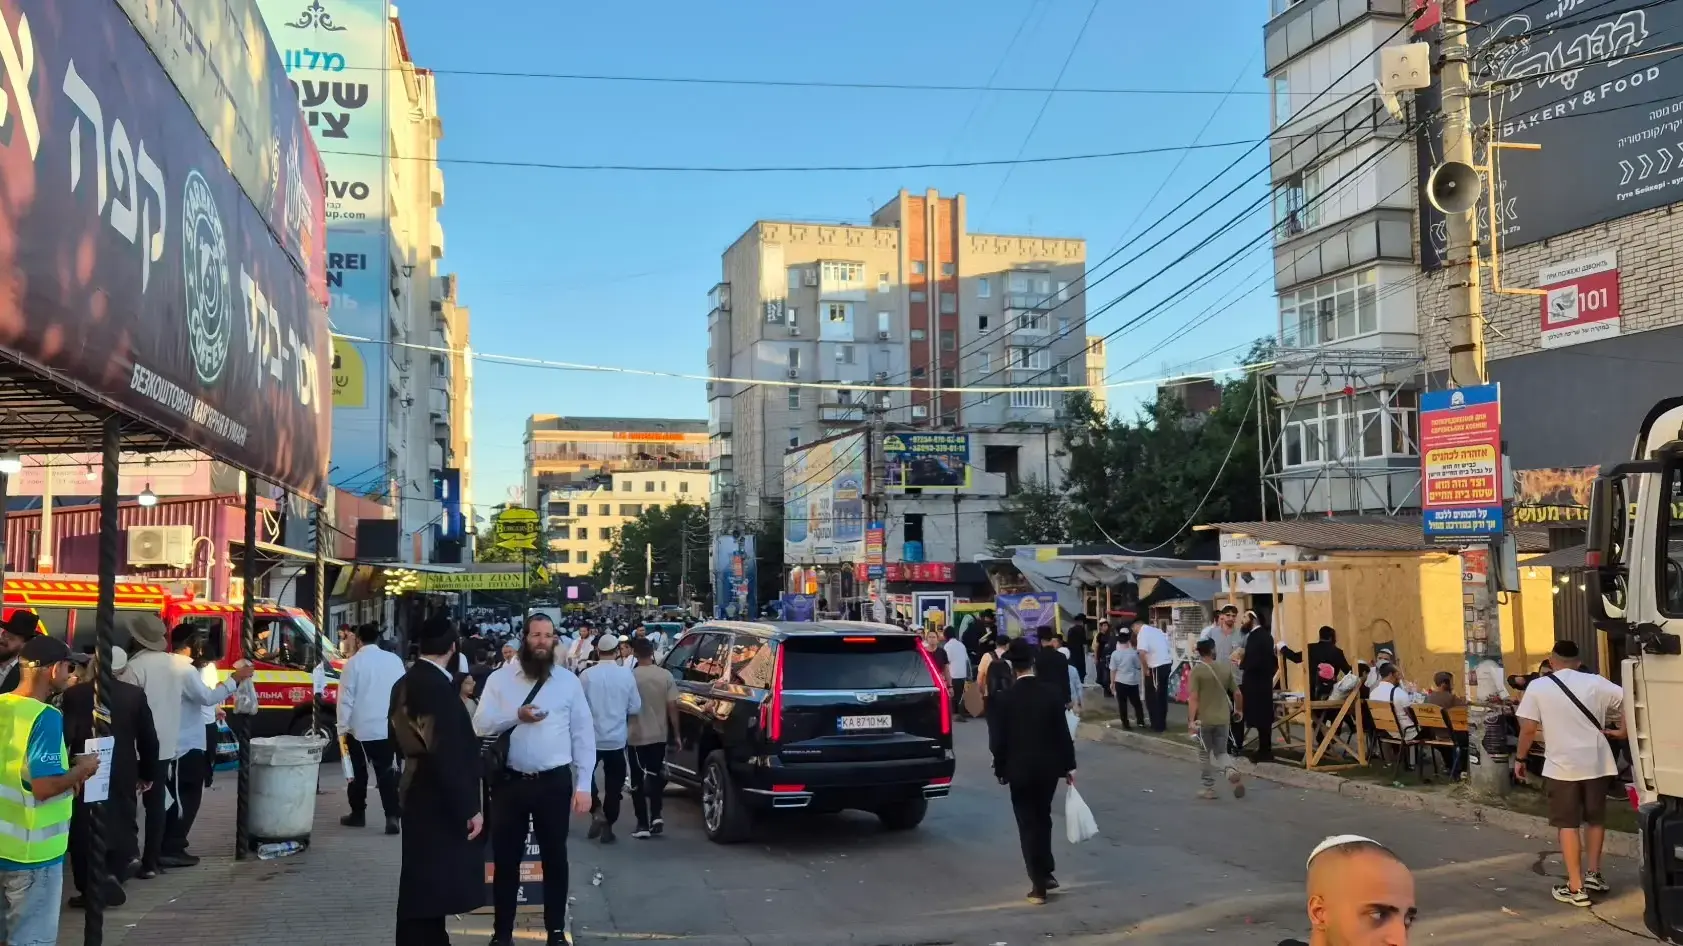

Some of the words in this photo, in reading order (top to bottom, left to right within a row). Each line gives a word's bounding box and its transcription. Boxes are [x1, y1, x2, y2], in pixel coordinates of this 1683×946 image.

[285, 48, 345, 73] מלון
[1503, 98, 1577, 137] BAKERY
[1583, 90, 1596, 105] &
[1600, 67, 1660, 99] FOOD
[301, 111, 350, 138] צי
[63, 57, 166, 294] קפה
[326, 253, 367, 270] REI
[1578, 288, 1608, 312] 101
[130, 363, 193, 417] БЕЗКОШТОВНА
[428, 573, 483, 581] SHAAREI
[490, 573, 521, 581] ZION
[843, 718, 855, 727] KA
[857, 717, 875, 726] 8710
[877, 717, 889, 725] MK
